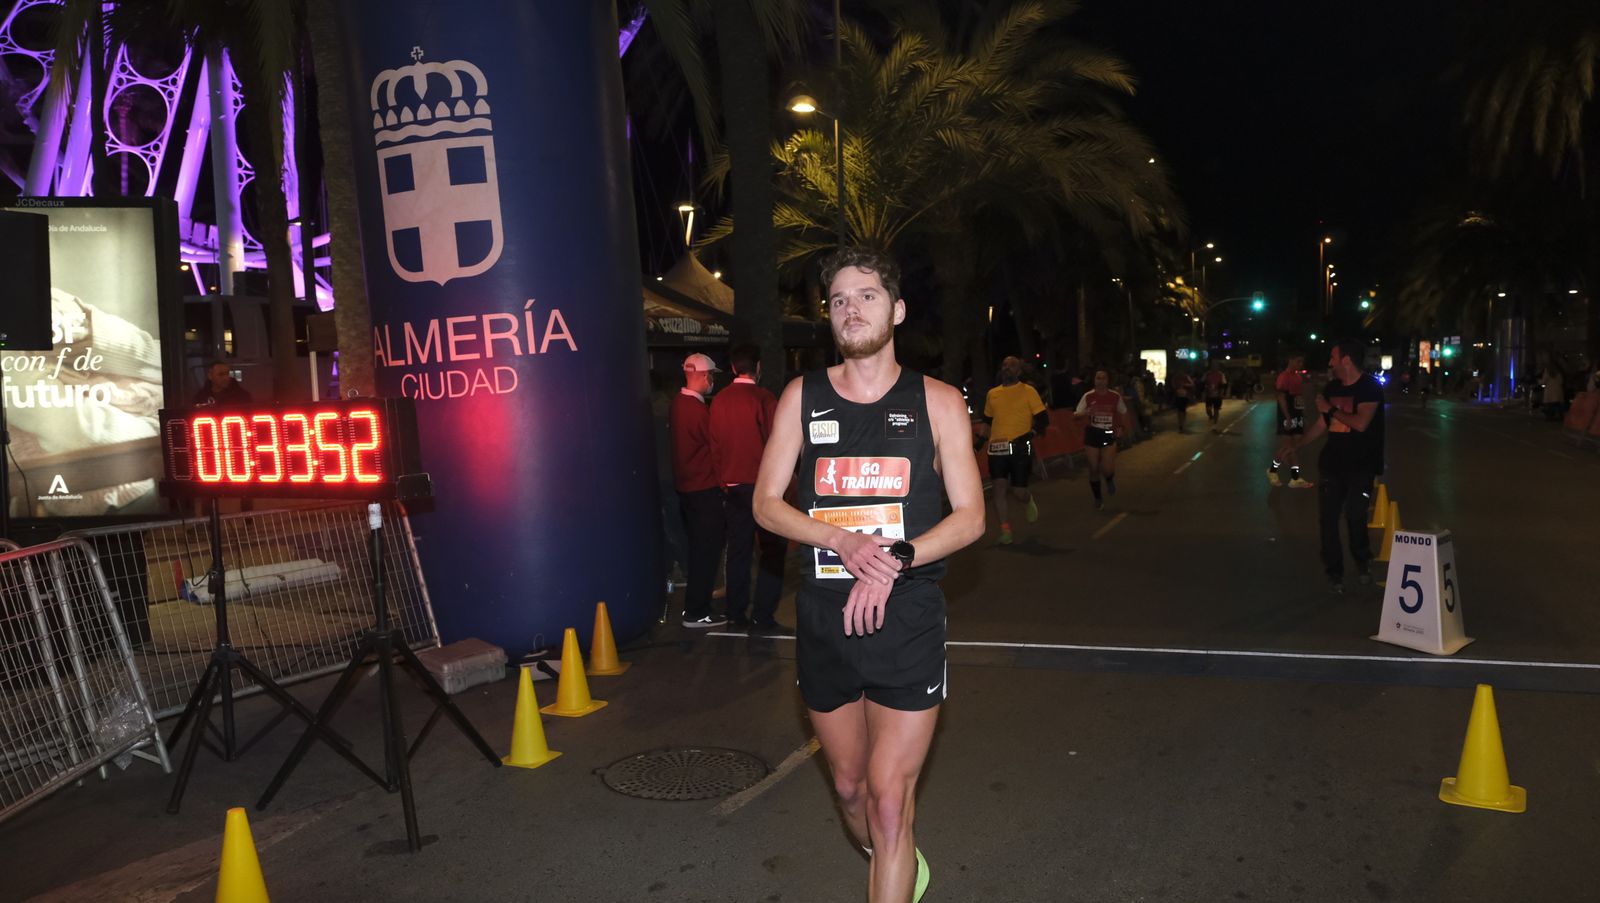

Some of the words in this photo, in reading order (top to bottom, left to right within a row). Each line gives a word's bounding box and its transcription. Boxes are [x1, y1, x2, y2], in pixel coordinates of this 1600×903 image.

[15, 198, 65, 207] JCDecaux
[374, 298, 578, 368] ALMERÍA
[1, 355, 46, 372] con
[48, 347, 72, 380] f
[73, 347, 104, 372] de
[401, 366, 519, 400] CIUDAD
[811, 422, 837, 434] FISIO
[192, 410, 381, 483] 00:33:52
[841, 476, 903, 490] TRAINING
[1394, 534, 1432, 547] MONDO
[1398, 563, 1424, 614] 5
[1443, 562, 1456, 614] 5
